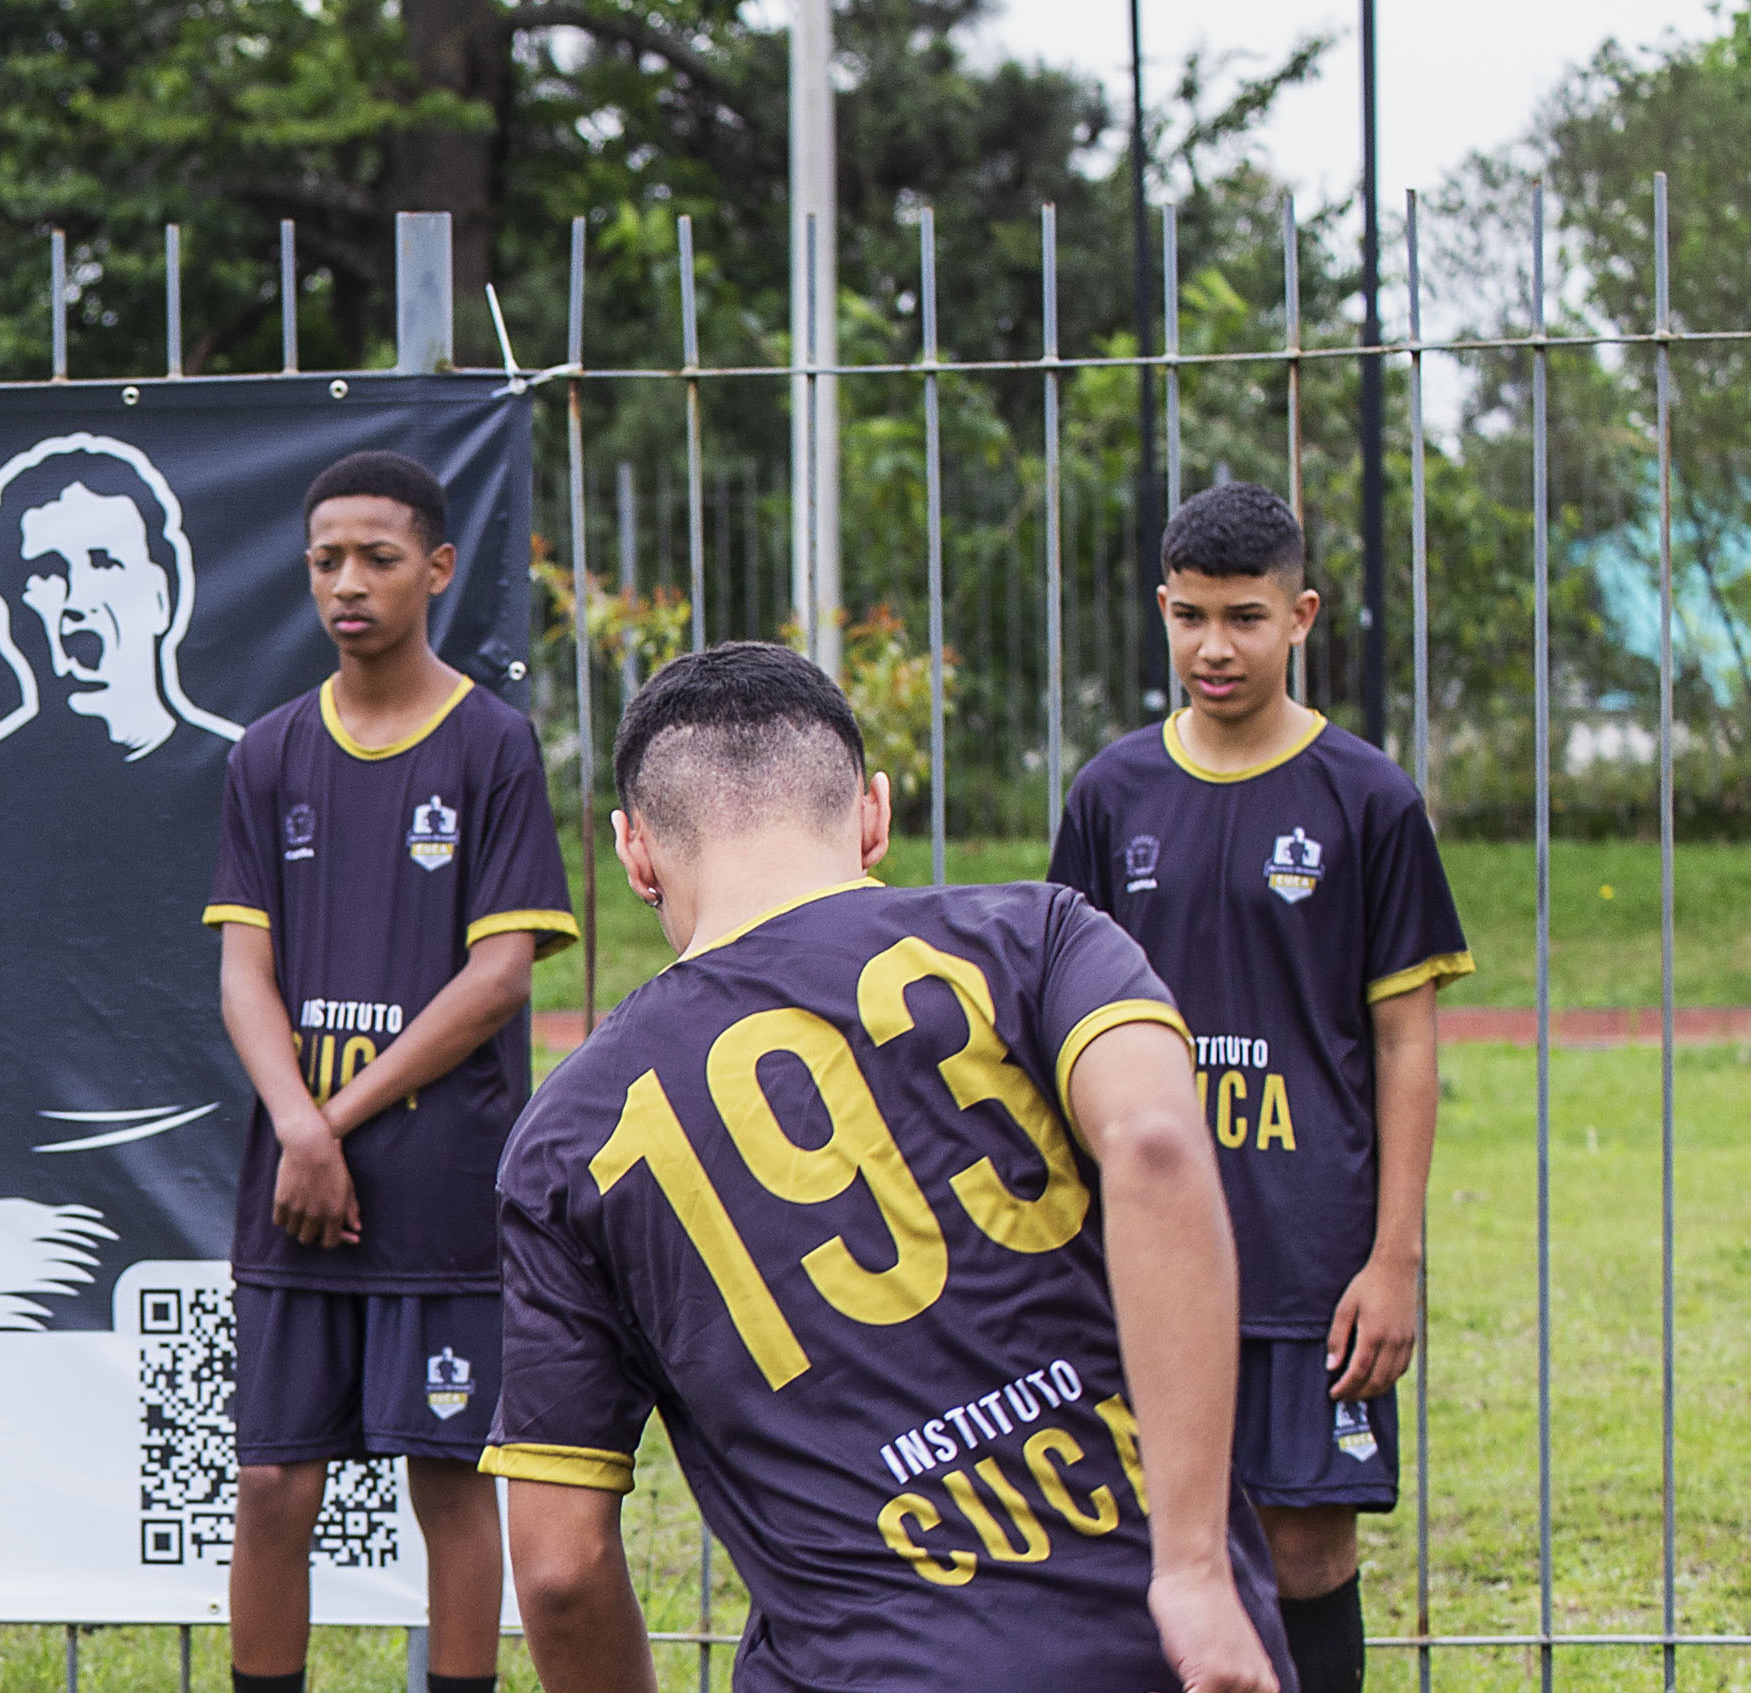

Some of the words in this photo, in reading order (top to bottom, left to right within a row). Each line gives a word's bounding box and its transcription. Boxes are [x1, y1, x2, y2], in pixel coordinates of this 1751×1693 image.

[1189, 1035, 1268, 1068] TITUTO
[587, 936, 1088, 1391] 193
[880, 1360, 1083, 1484] INSTITUTO
